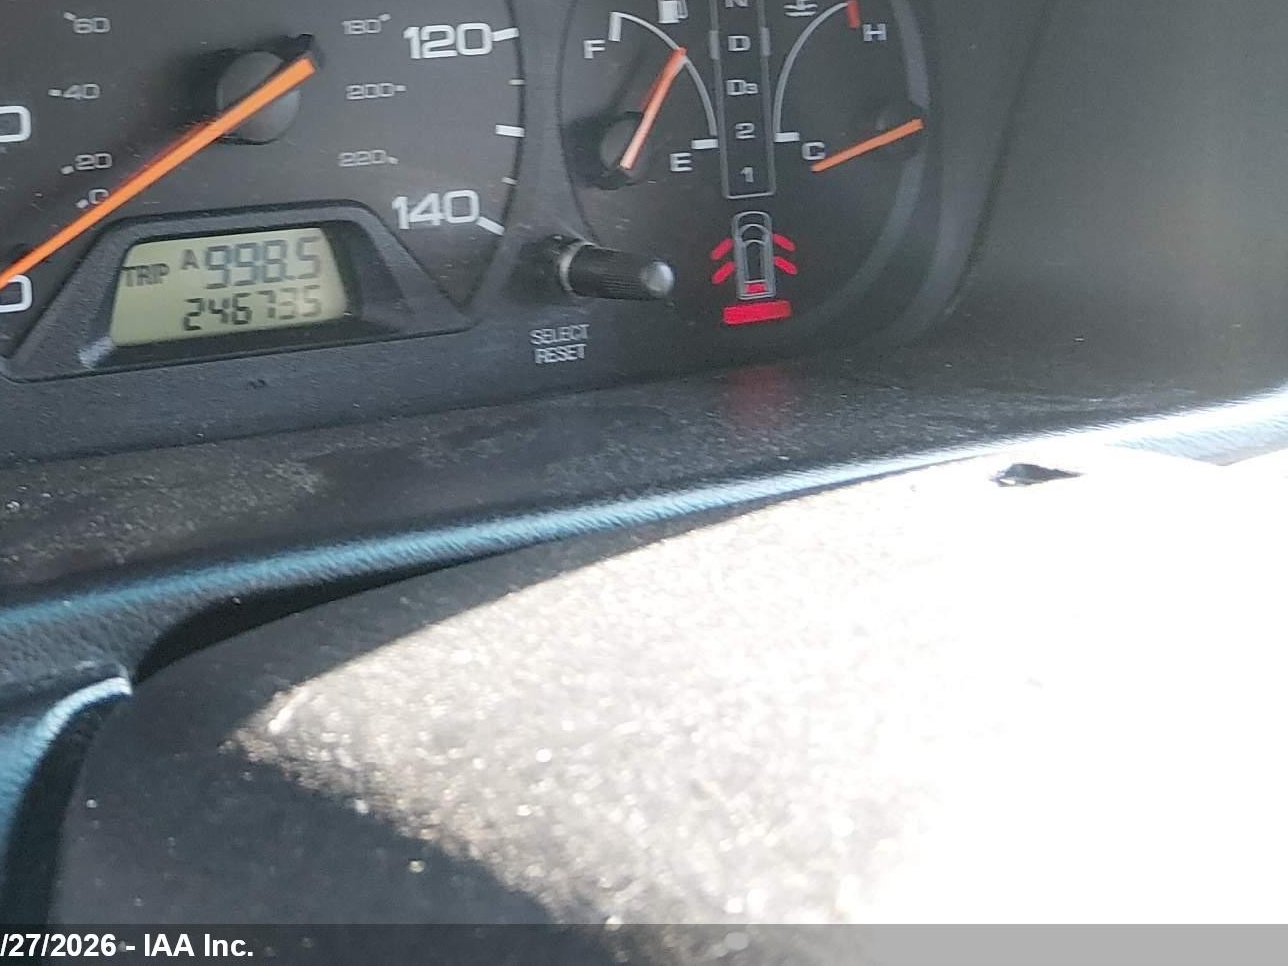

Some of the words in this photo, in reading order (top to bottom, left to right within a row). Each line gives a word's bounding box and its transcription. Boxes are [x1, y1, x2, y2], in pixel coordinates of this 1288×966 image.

[73, 16, 111, 34] 60
[342, 17, 382, 35] 180
[863, 23, 887, 42] H
[403, 22, 494, 60] 120
[583, 39, 606, 59] F
[727, 35, 751, 52] D
[63, 83, 100, 100] 40
[346, 83, 394, 100] 200
[735, 122, 756, 140] 2
[339, 149, 388, 167] 220
[802, 141, 826, 161] C
[75, 152, 112, 171] 20
[670, 152, 692, 172] E
[740, 166, 754, 183] 1
[391, 189, 480, 230] 140
[121, 263, 170, 287] TRIP
[180, 248, 200, 270] A
[203, 235, 323, 289] 998.5
[182, 284, 323, 331] 246735
[529, 324, 590, 345] SELECT
[535, 343, 587, 364] RESET
